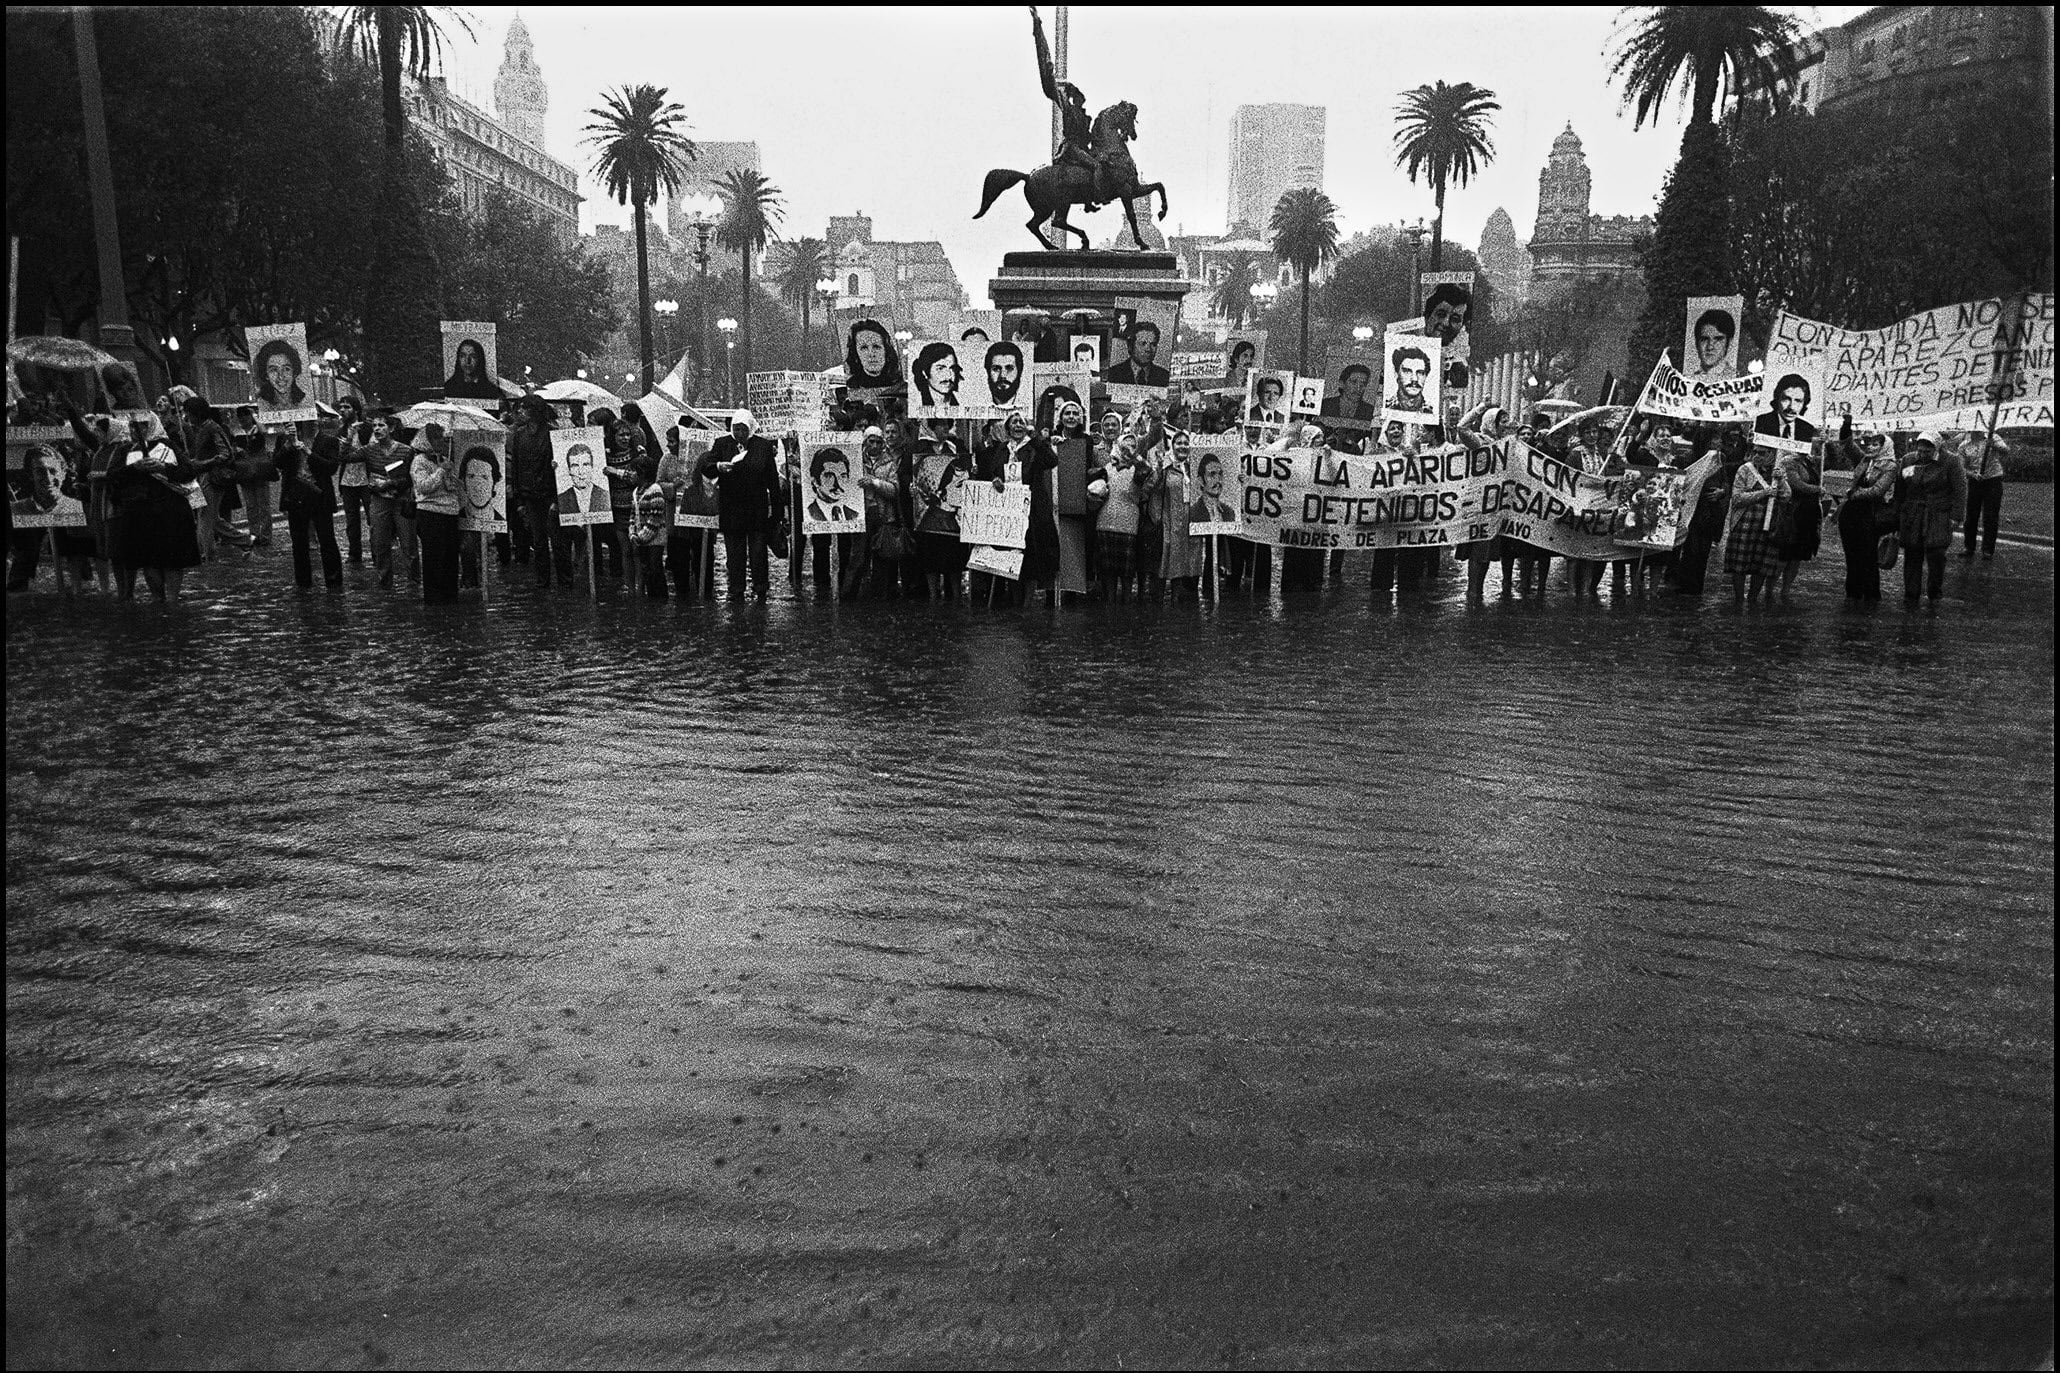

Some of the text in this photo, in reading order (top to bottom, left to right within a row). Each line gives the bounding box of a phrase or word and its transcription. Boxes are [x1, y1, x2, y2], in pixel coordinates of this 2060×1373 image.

[1778, 314, 1834, 346] CON
[1880, 311, 1938, 344] VIDA
[1957, 300, 2001, 330] NO
[1827, 361, 1940, 392] DIANTES
[1861, 399, 1873, 416] A
[1882, 394, 1924, 415] LOS
[803, 429, 851, 443] CHAVEZ
[1313, 455, 1350, 488] LA
[1370, 440, 1510, 489] APARICION
[1526, 450, 1581, 498] CON
[1302, 491, 1459, 526] DETENIDOS
[1279, 528, 1339, 547] MADRES
[1356, 532, 1376, 547] DE
[1397, 528, 1448, 546] PLAZA
[1469, 523, 1489, 540] DE
